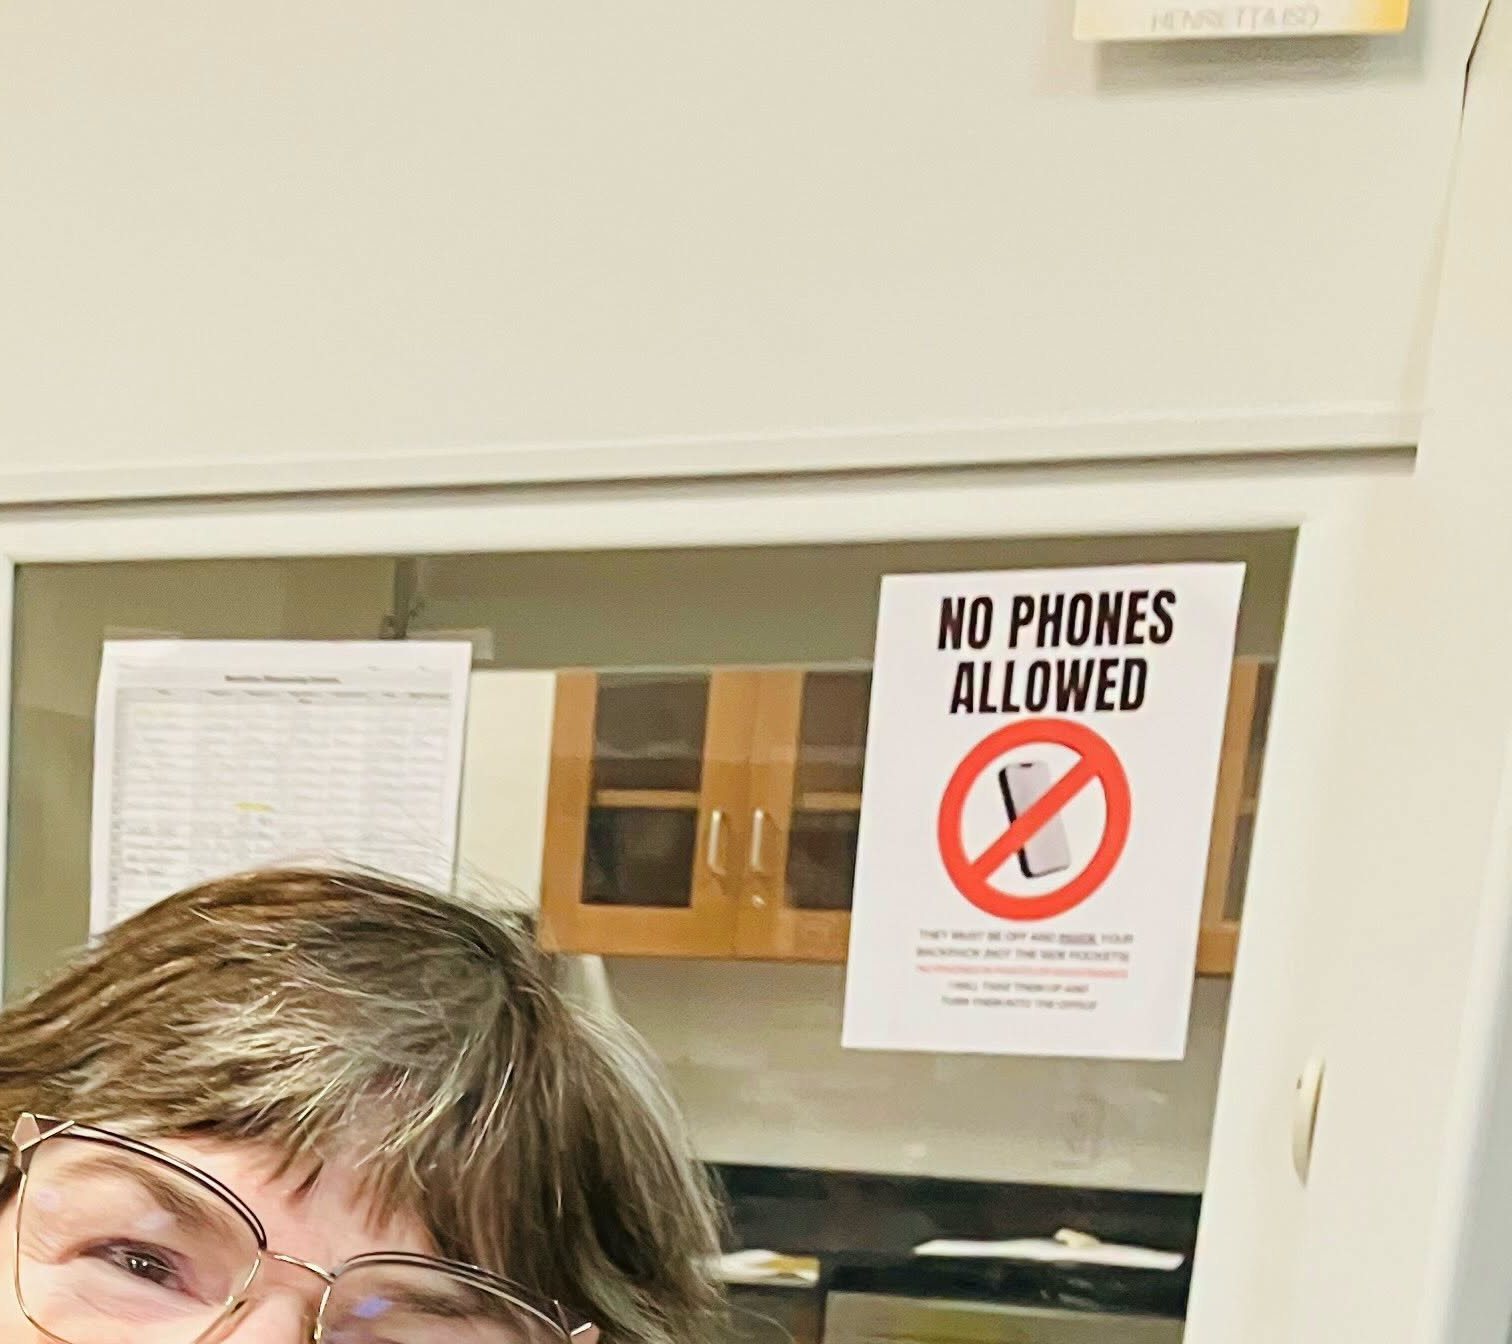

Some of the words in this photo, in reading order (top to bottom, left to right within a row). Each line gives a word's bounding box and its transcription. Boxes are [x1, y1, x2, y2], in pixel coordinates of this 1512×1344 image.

[937, 595, 994, 651] NO
[1007, 589, 1177, 649] PHONES
[949, 657, 1148, 714] ALLOWED
